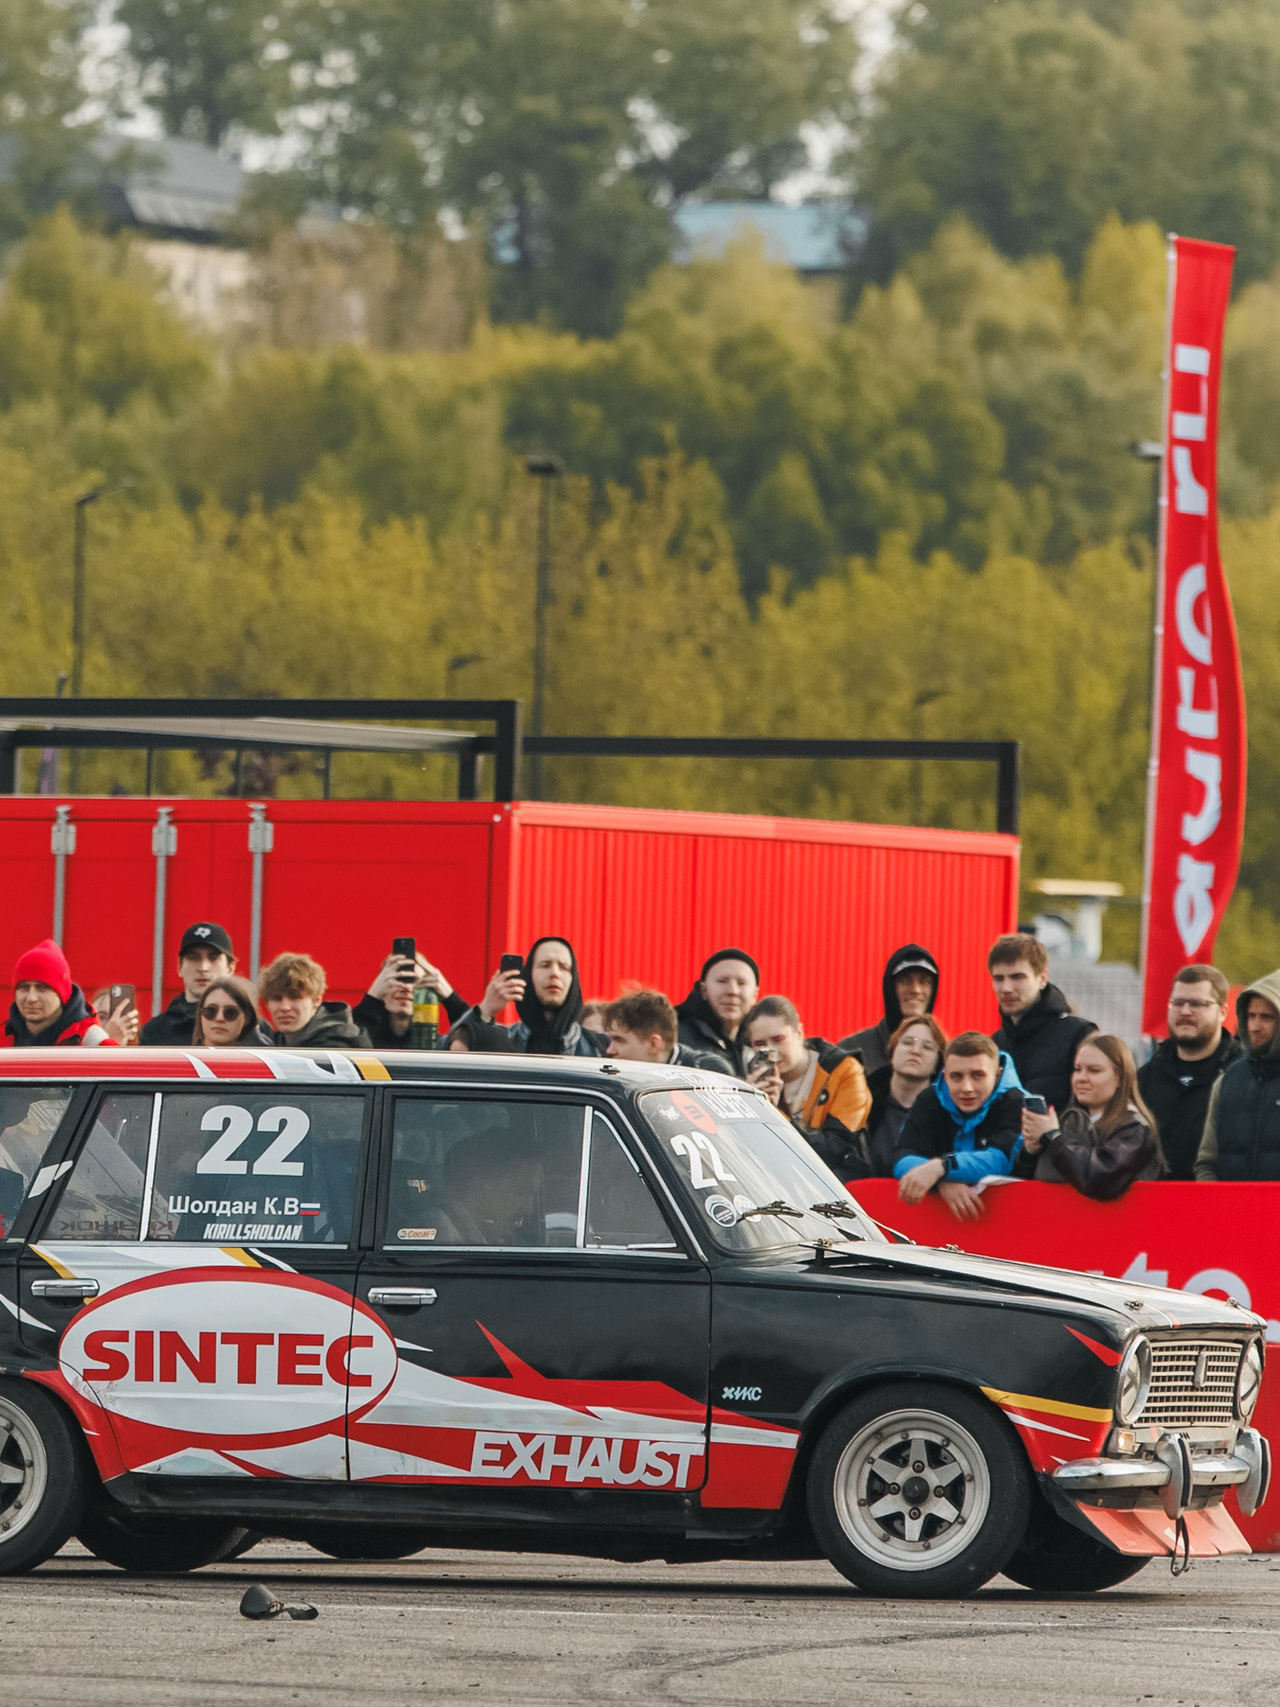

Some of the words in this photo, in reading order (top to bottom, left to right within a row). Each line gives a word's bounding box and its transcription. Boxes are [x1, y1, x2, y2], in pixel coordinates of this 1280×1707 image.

[1172, 342, 1223, 957] autoru
[196, 1105, 311, 1177] 22
[670, 1131, 737, 1189] 22
[169, 1196, 256, 1216] Шолдан
[203, 1223, 302, 1241] KIRILLSHOLDAN
[82, 1330, 374, 1388] SINTEC
[470, 1430, 705, 1489] EXHAUST
